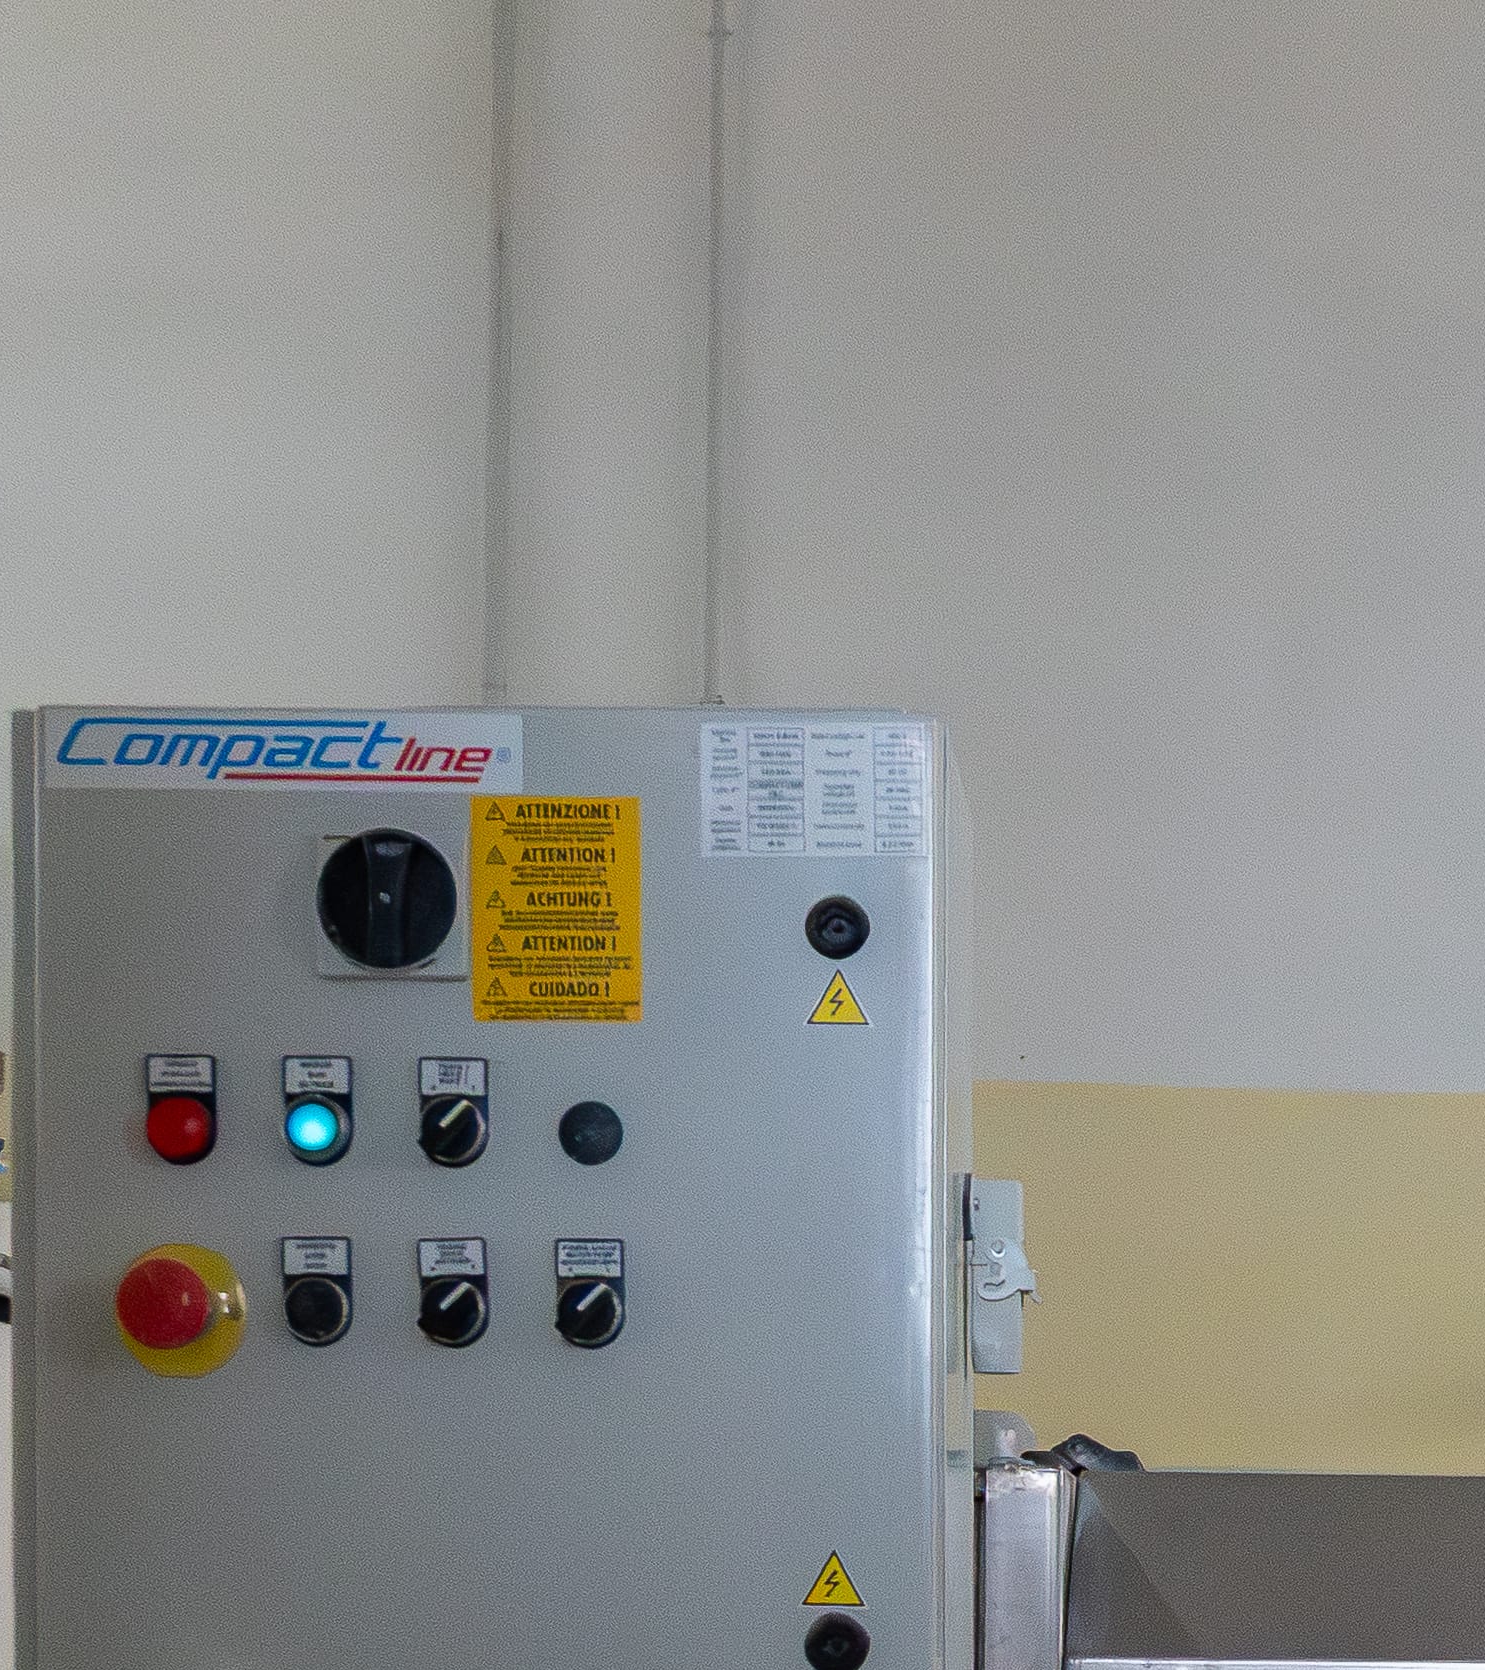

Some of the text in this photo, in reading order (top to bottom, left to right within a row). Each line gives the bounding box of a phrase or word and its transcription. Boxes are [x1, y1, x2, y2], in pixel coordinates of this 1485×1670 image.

[515, 803, 612, 820] ATTENZIONE
[521, 847, 606, 864] ATTENTION
[526, 891, 602, 908] ACHTUNG
[521, 935, 607, 951] ATTENTION
[528, 981, 600, 997] CUIDADO
